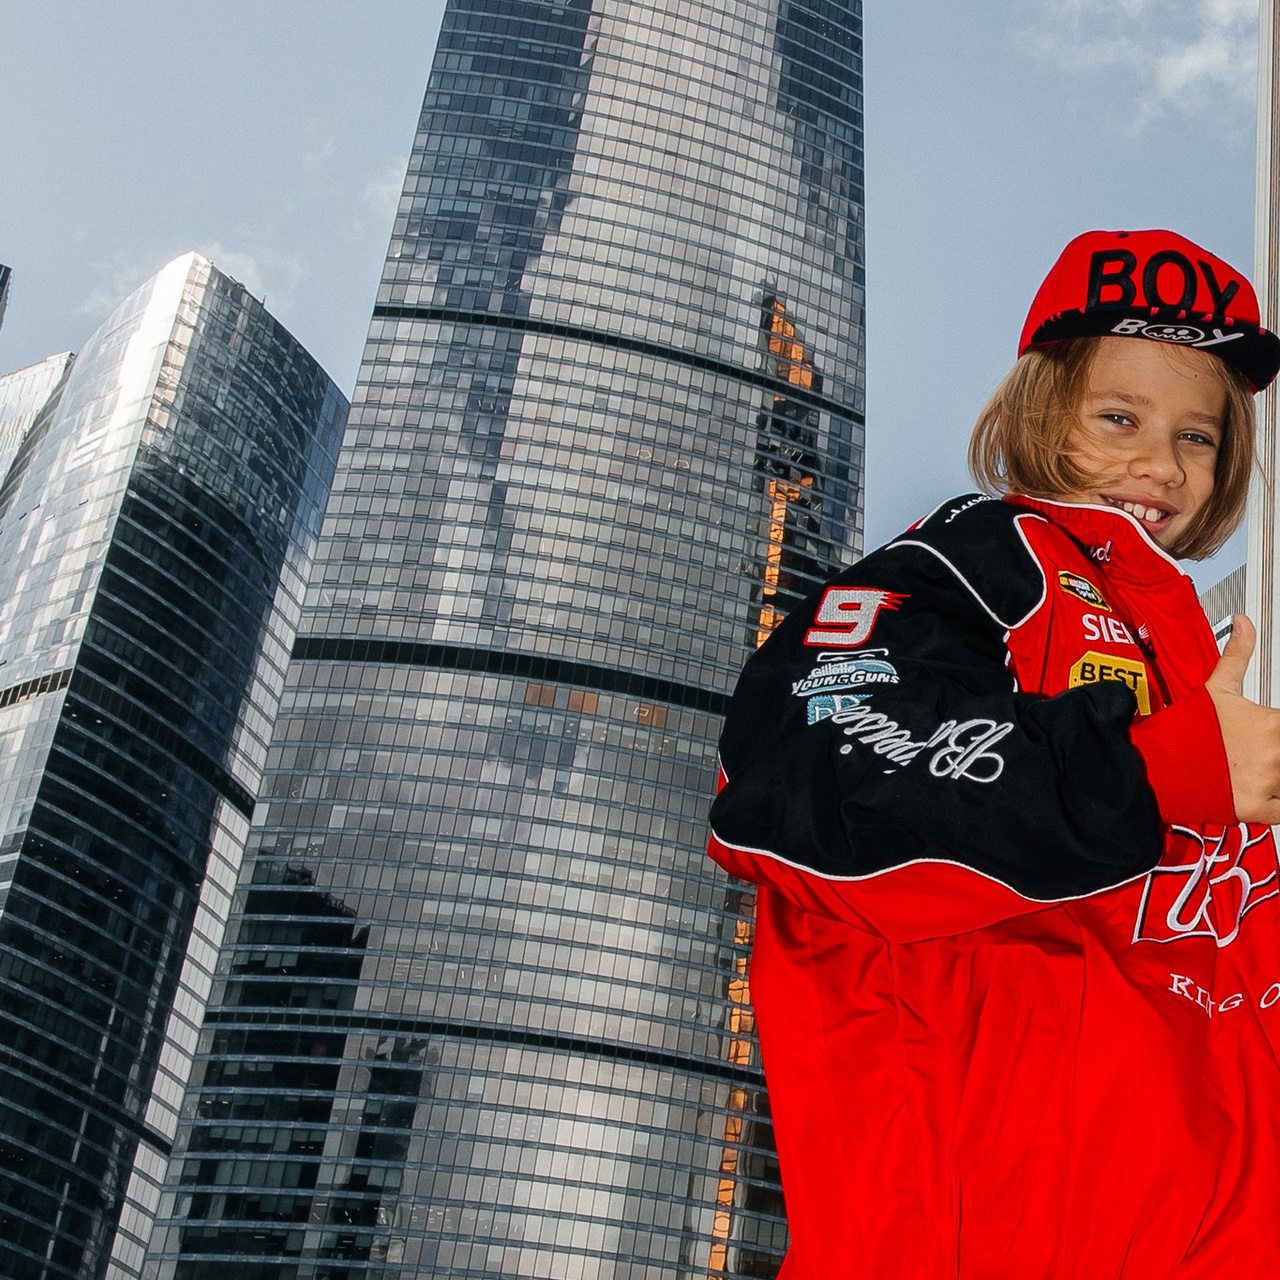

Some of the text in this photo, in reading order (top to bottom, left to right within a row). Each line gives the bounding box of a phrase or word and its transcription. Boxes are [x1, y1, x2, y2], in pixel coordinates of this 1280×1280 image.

[1086, 249, 1240, 318] BOY
[804, 586, 892, 648] 9
[1080, 662, 1143, 691] BEST
